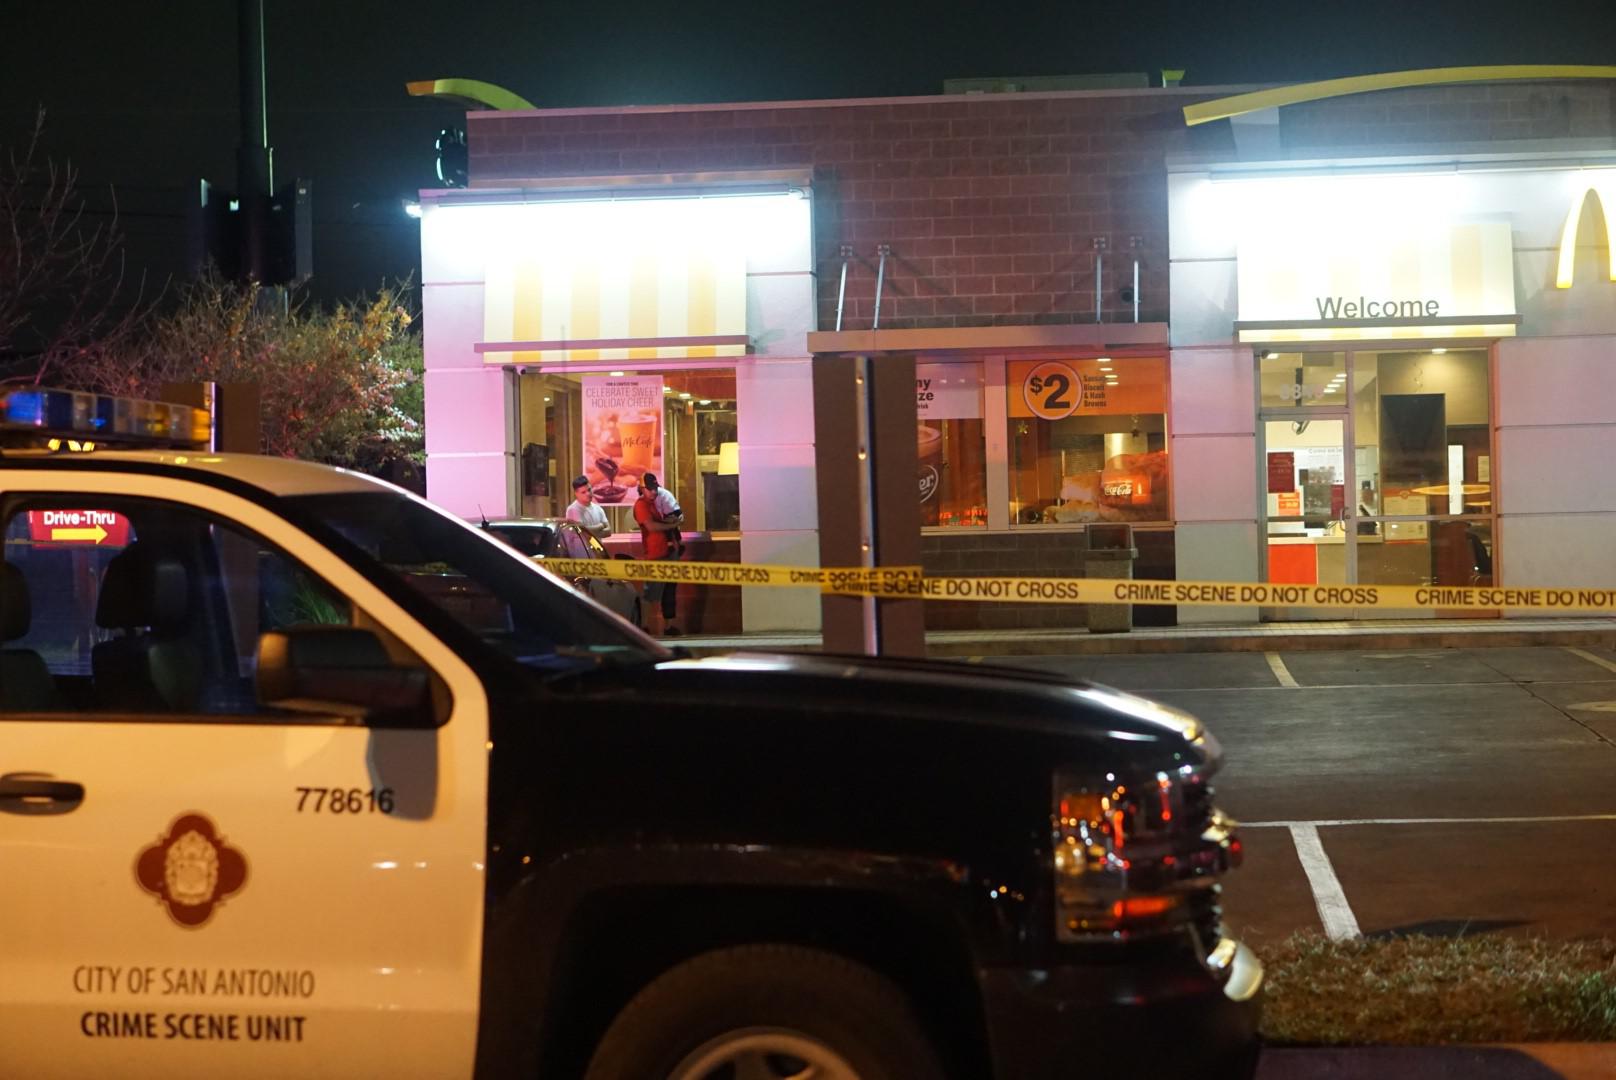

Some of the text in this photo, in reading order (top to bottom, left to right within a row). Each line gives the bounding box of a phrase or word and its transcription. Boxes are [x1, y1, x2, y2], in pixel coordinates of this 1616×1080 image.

[1316, 297, 1440, 319] Welcome
[586, 386, 658, 398] CELEBRATE SWEET
[1030, 374, 1071, 409] $2
[591, 397, 655, 409] HOLIDAY CHEER
[43, 510, 116, 525] Drive-Thru
[573, 561, 608, 576] CROSS
[624, 563, 770, 583] CRIME SCENE DO NOT CROSS
[883, 578, 942, 595] SCENE
[946, 580, 972, 596] DO
[976, 581, 1012, 597] NOT
[1016, 581, 1079, 599] CROSS
[1114, 583, 1378, 604] CRIME SCENE DO NOT CROSS
[1415, 589, 1616, 606] CRIME SCENE DO NOT
[296, 787, 395, 814] 778616
[74, 965, 316, 998] CITY OF SAN ANTONIO
[81, 1011, 307, 1042] CRIME SCENE UNIT
